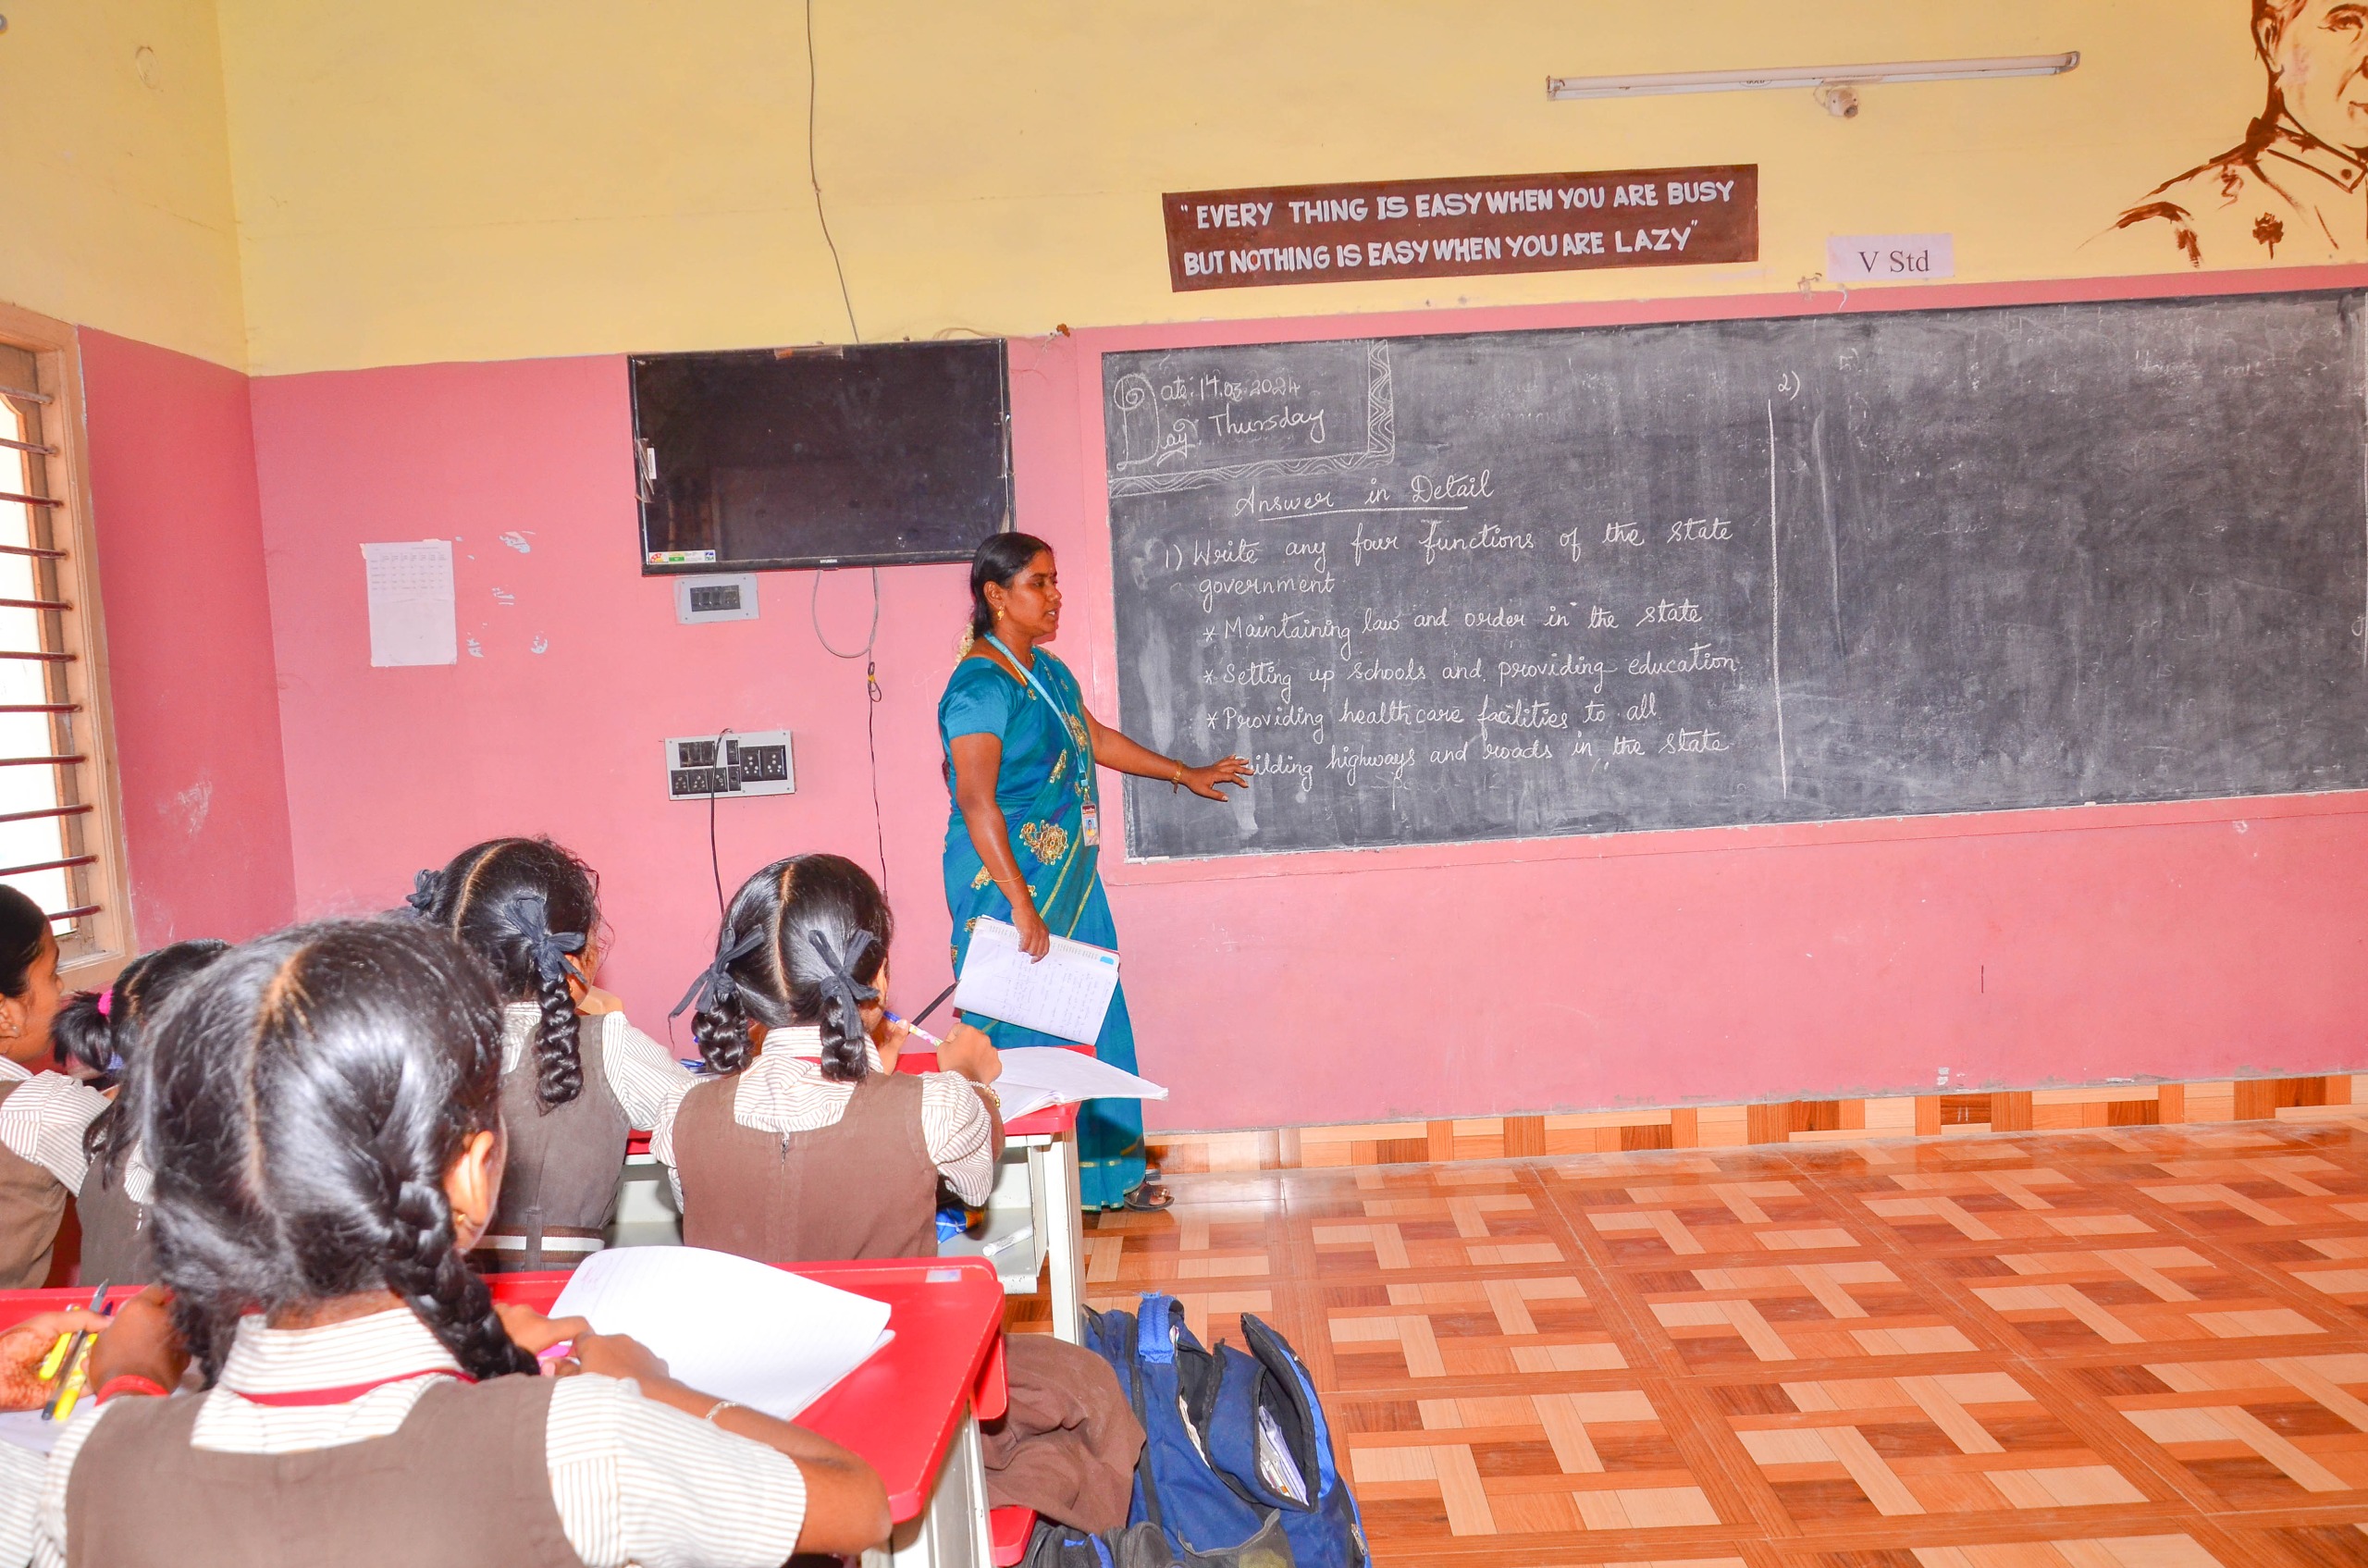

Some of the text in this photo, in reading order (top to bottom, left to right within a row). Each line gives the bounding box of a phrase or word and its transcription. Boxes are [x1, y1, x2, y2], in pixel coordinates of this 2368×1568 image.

[1289, 199, 1368, 224] THING
[1376, 196, 1409, 220] IS
[1416, 192, 1482, 218] EASY
[1486, 189, 1553, 214] WHEN
[1558, 186, 1605, 209] YOU
[1613, 184, 1659, 207] ARE
[1667, 180, 1734, 205] BUSY
[1183, 250, 1225, 276] BUT
[1229, 245, 1330, 273] NOTHING
[1337, 243, 1363, 267] IS
[1367, 240, 1428, 266] EASY
[1433, 237, 1500, 263] WHEN
[1505, 235, 1558, 257] YOU
[1562, 232, 1605, 256] ARE
[1857, 250, 1930, 273] V Std
[1778, 370, 1800, 401] 2)
[1208, 402, 1326, 443] Thursday
[1234, 469, 1495, 517] Answer in Detail
[1165, 518, 1733, 574] 1) Write any four functions of the state
[1199, 572, 1335, 612] government
[1225, 599, 1703, 661] Maintaining law and order in the state
[1223, 661, 1292, 704] Setting
[1309, 670, 1335, 692] up
[1347, 658, 1425, 681] schools
[1498, 652, 1618, 694] providing
[1223, 706, 1324, 745] Providing
[1477, 695, 1568, 741] facilities
[1583, 700, 1606, 722] to
[1326, 745, 1415, 786] highways
[1430, 741, 1468, 764] and
[1572, 731, 1593, 757] in
[1612, 735, 1646, 757] the
[1659, 727, 1729, 754] state
